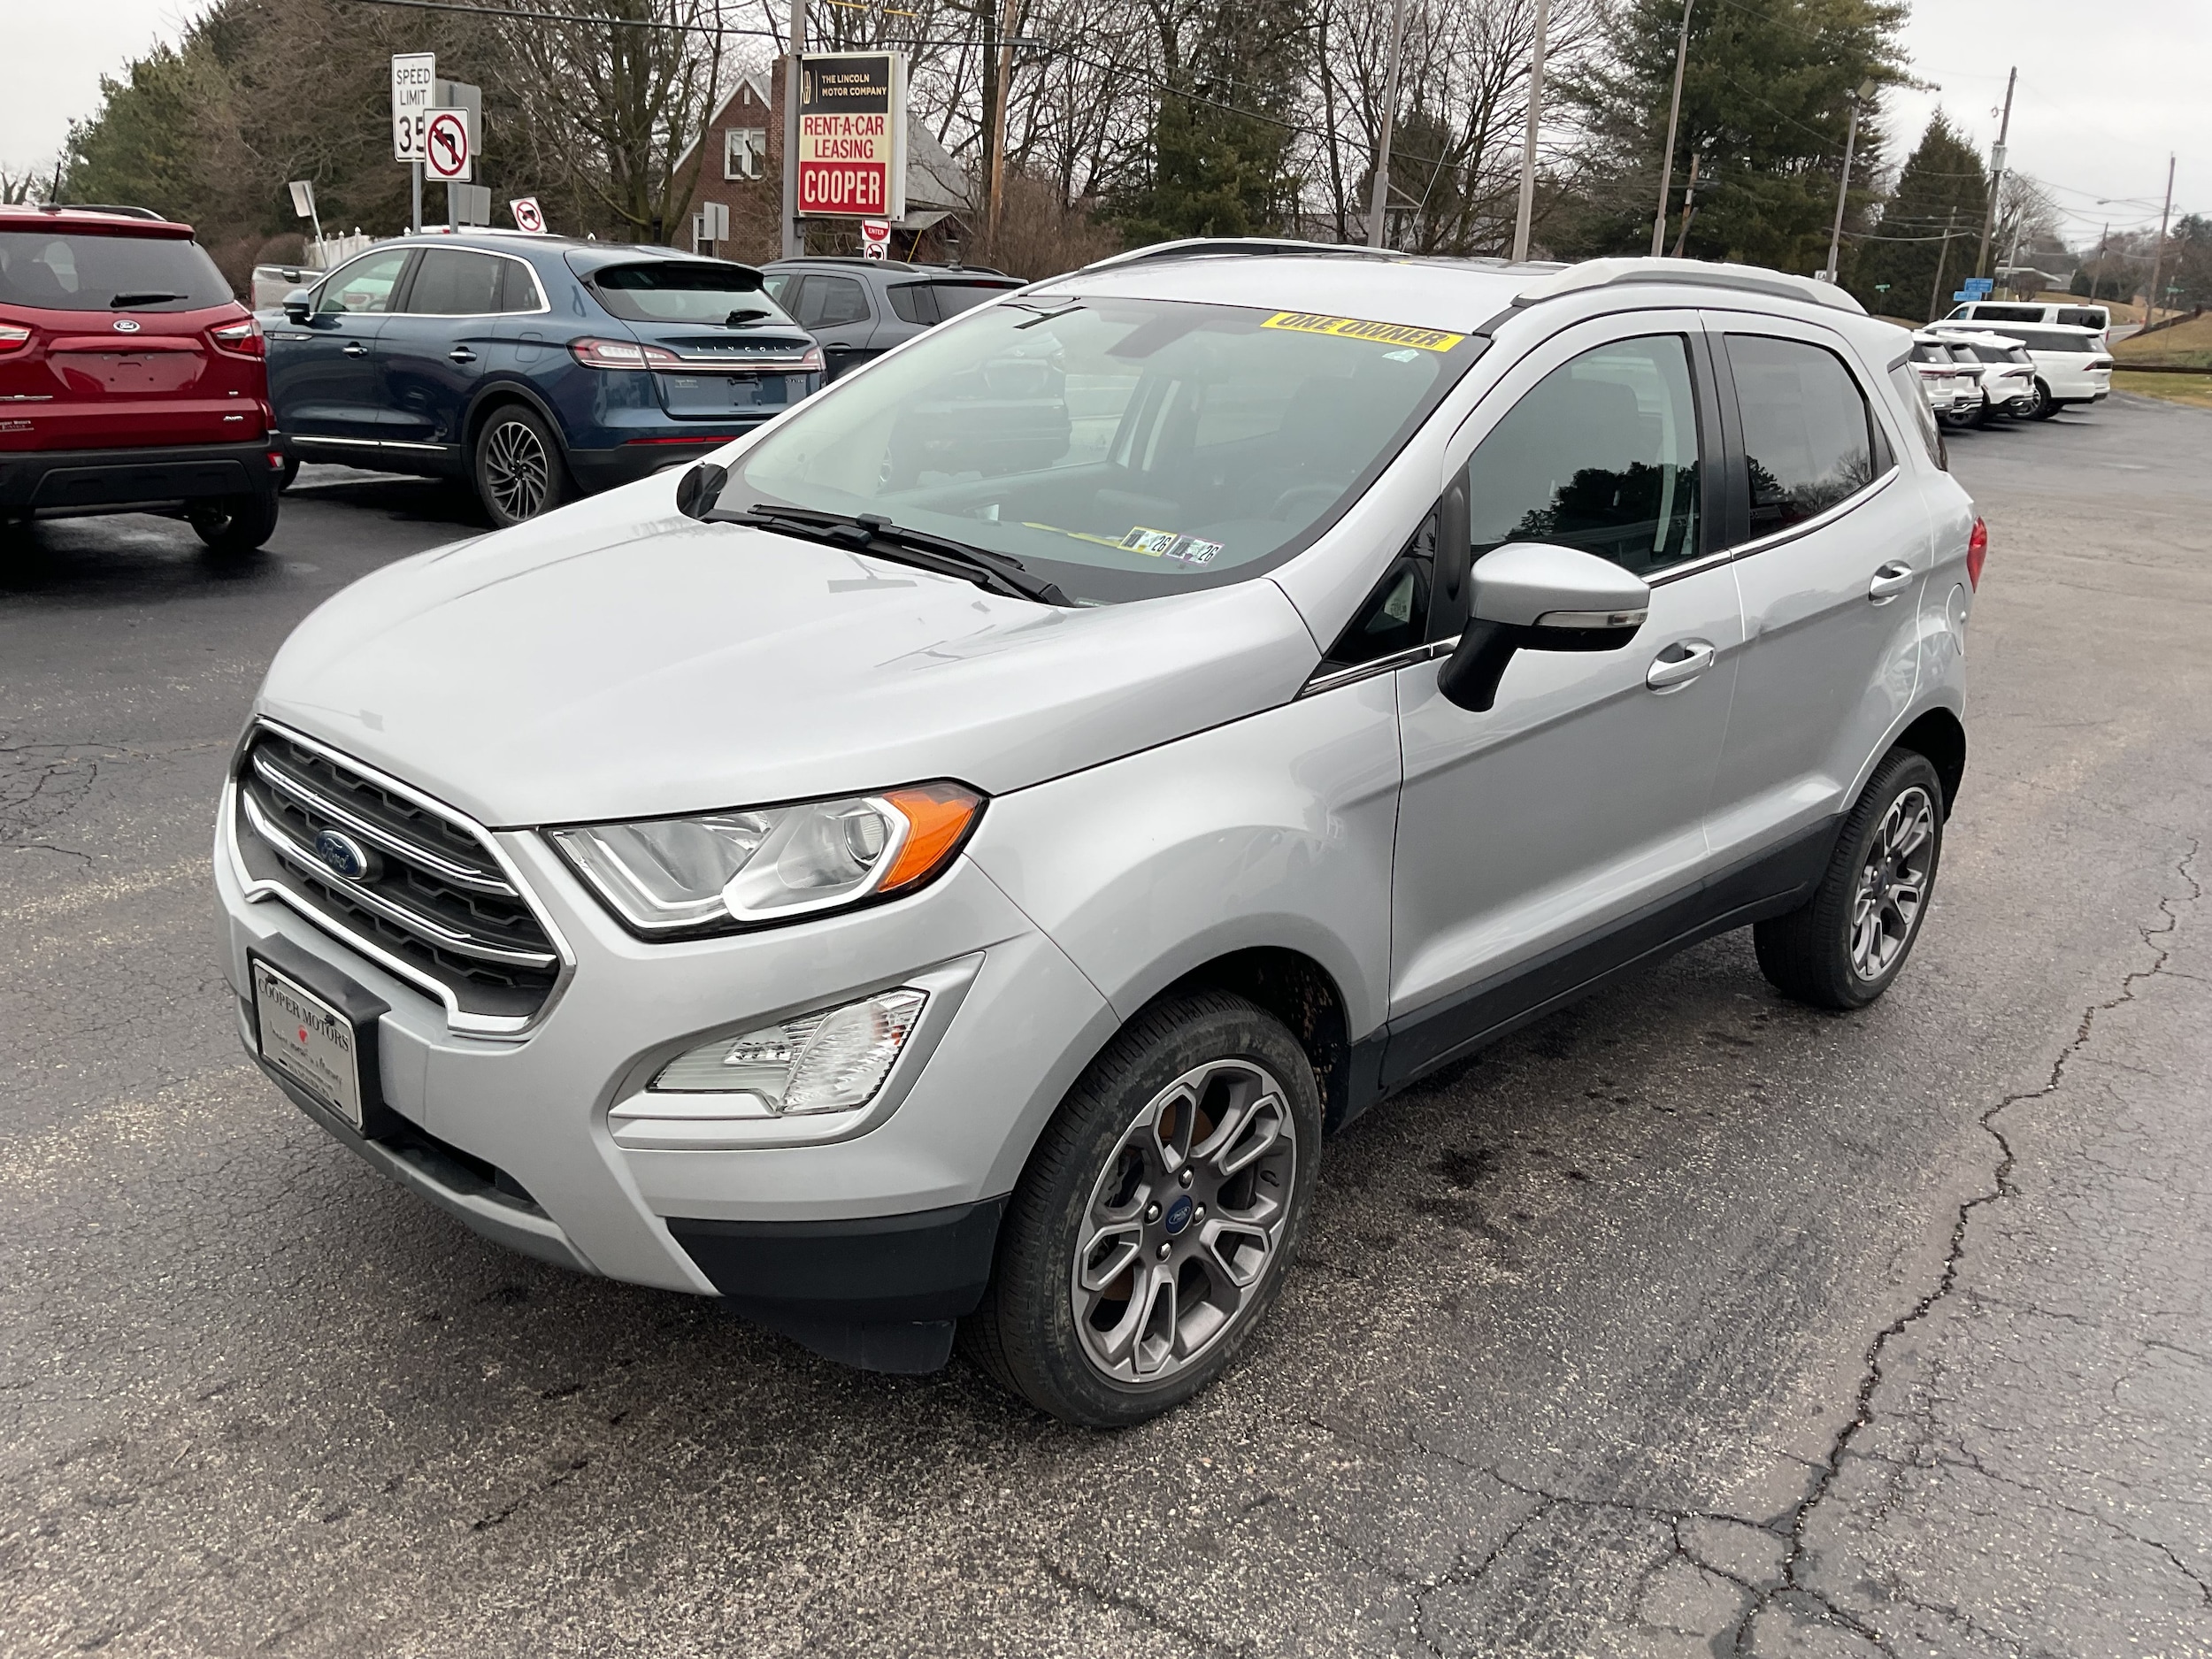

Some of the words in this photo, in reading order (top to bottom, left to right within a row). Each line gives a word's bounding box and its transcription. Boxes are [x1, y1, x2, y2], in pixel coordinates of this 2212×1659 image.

[396, 68, 431, 85] SPEED
[821, 74, 836, 84] THE
[837, 73, 870, 83] LINCOLN
[400, 89, 426, 106] LIMIT
[821, 87, 849, 96] MOTOR
[849, 86, 887, 96] COMPANY
[804, 115, 884, 136] RENT-A-CAR
[815, 139, 873, 158] LEASING
[804, 170, 880, 205] COOPER
[868, 227, 885, 235] ENTER
[1277, 315, 1343, 331] ONE
[1337, 321, 1449, 347] OWNER
[1151, 535, 1171, 552] 26
[1198, 545, 1219, 562] 26
[258, 978, 301, 1019] COOPER
[303, 1009, 349, 1052] MOTORS
